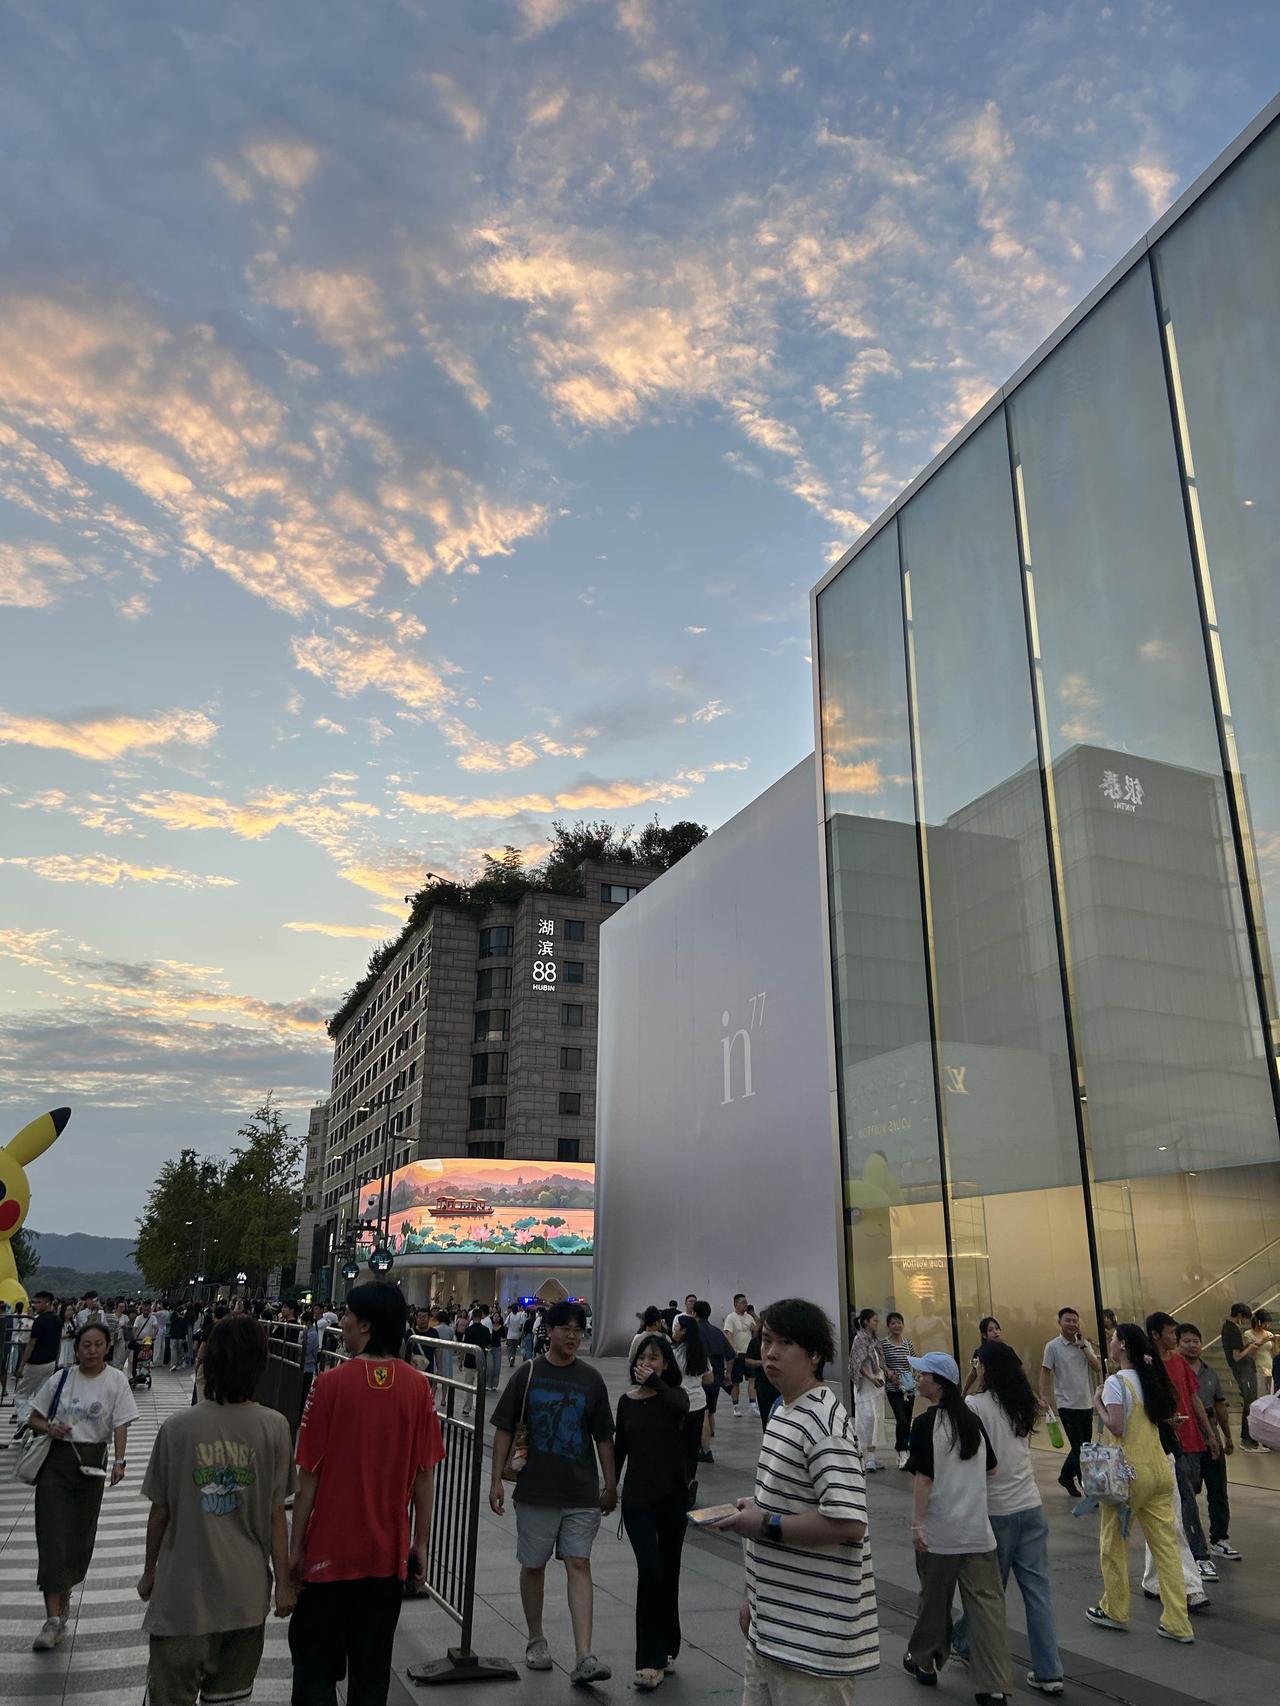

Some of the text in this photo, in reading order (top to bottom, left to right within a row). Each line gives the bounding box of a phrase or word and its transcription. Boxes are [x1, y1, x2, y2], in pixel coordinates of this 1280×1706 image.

[537, 918, 554, 957] 湖滨
[532, 960, 557, 982] 88
[532, 983, 556, 992] HUBIN
